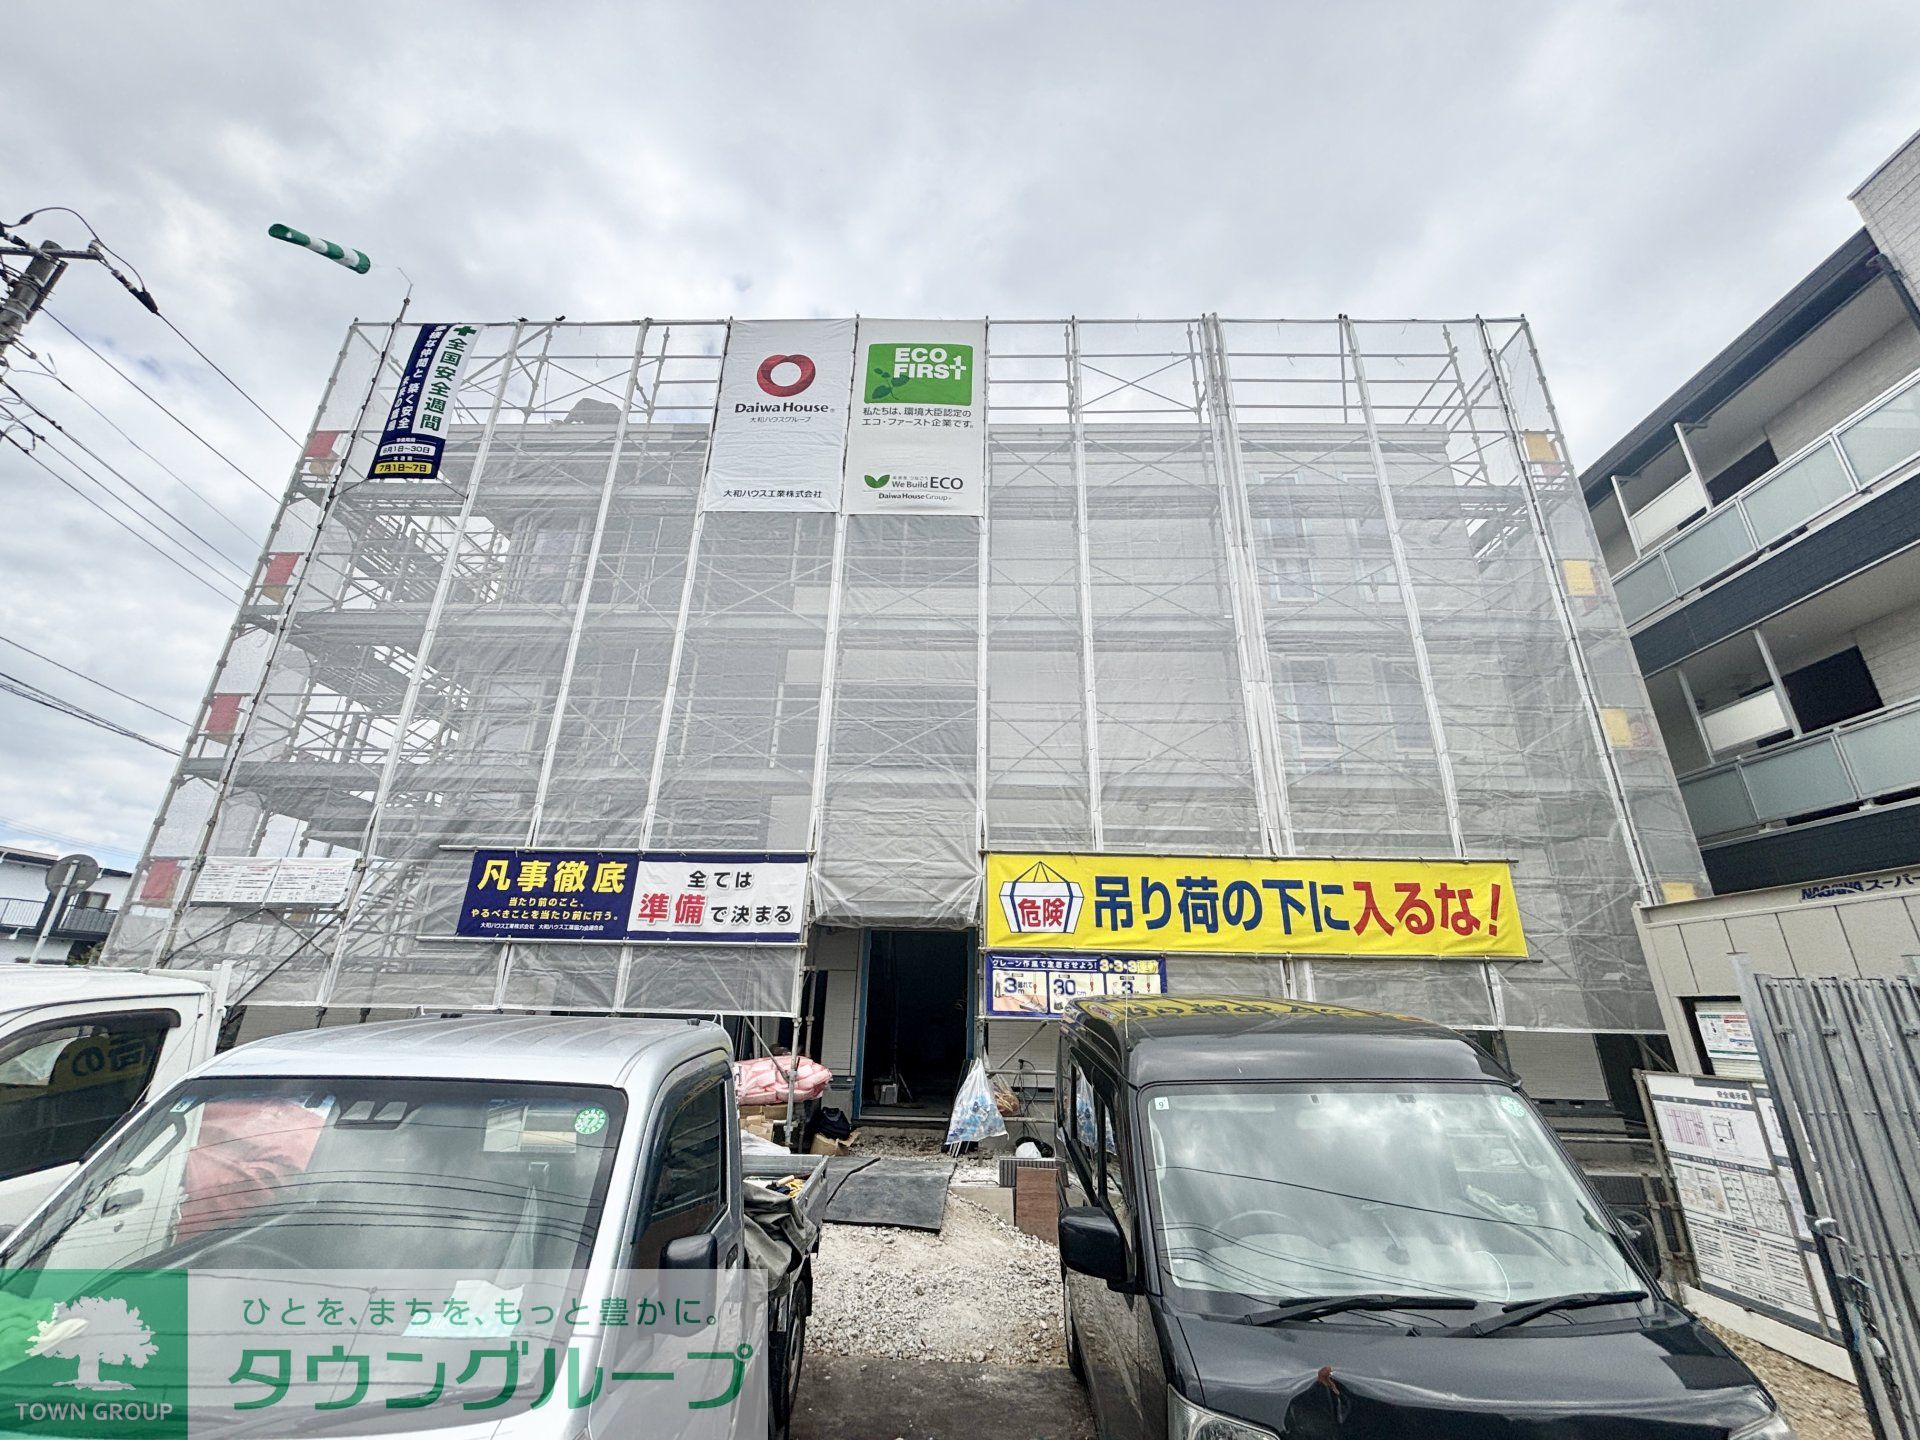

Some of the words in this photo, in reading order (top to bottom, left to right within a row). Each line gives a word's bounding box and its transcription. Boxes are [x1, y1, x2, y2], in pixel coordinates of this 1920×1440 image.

[894, 347, 948, 363] ECO
[419, 337, 468, 432] 全国安全週間
[735, 402, 781, 413] Daiwa
[782, 402, 829, 413] House
[863, 407, 972, 418] 私たちは、環境大臣認定の
[749, 416, 812, 424] 大和ハウスグループ
[861, 418, 974, 429] エコ・ファースト企業です。
[891, 481, 905, 489] We
[906, 481, 928, 489] Build
[930, 476, 964, 490] ECO
[722, 489, 823, 499] 大和ハウス工業株式会社
[878, 492, 902, 500] Daiwa
[925, 493, 948, 501] Group
[476, 859, 628, 894] 凡事徹底
[686, 869, 754, 889] 全ては
[1801, 880, 1865, 900] NAGAWA
[508, 897, 585, 908] 当たり前のこと、
[638, 892, 793, 924] 準備で決まる
[471, 908, 619, 921] やるべきことを当たり前に行う。
[1017, 898, 1066, 928] 危険
